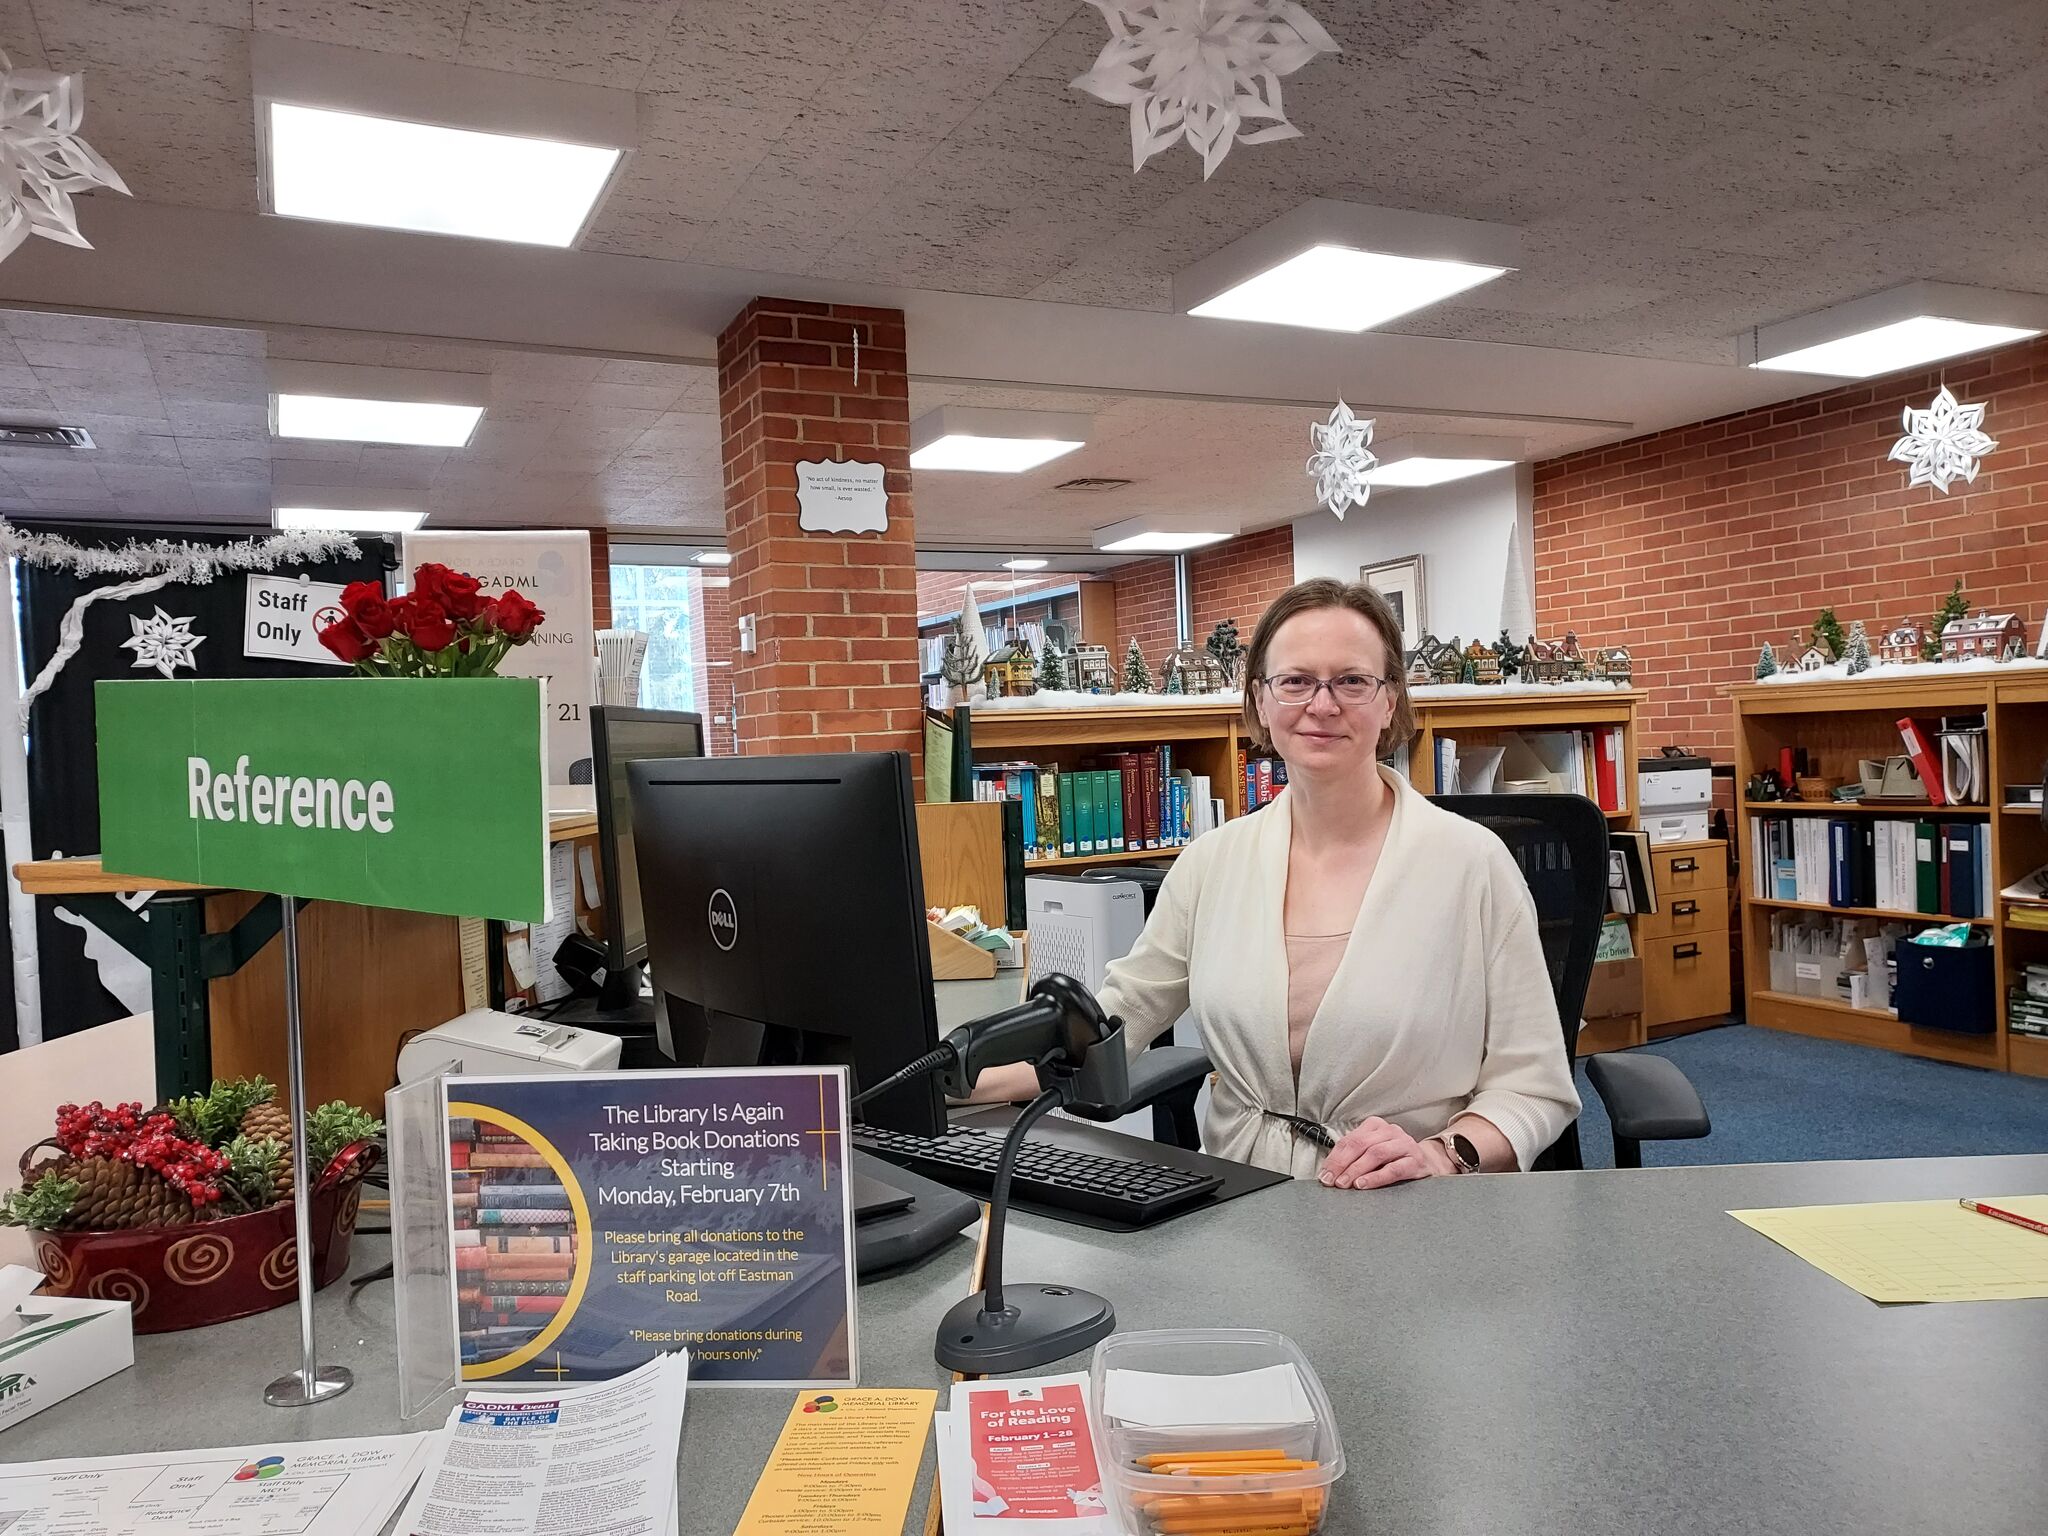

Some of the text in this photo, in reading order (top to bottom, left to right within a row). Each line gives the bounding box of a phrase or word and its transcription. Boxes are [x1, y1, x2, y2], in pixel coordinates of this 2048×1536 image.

[479, 575, 539, 588] GADML
[258, 590, 308, 612] Staff
[256, 622, 302, 646] Only
[558, 703, 582, 721] 21
[188, 754, 395, 834] Reference
[712, 911, 734, 928] DELL
[1609, 947, 1630, 957] Driver
[603, 1102, 784, 1126] The Library Is Again
[589, 1130, 800, 1154] Taking Book Donations
[661, 1158, 734, 1180] Starting
[599, 1183, 800, 1208] Monday, February 7th
[604, 1229, 804, 1245] Please bring all donations to the
[612, 1248, 798, 1266] Library's garage located in the
[618, 1268, 794, 1286] staff parking lot off Eastman
[666, 1290, 702, 1302] Road.
[674, 1329, 704, 1344] bring
[706, 1328, 763, 1341] donations
[764, 1328, 803, 1342] during
[698, 1348, 731, 1361] hours
[584, 1390, 617, 1401] February
[466, 1402, 554, 1411] GADML Events
[980, 1406, 1076, 1419] For the Love
[988, 1416, 1071, 1428] of Reading
[988, 1434, 1040, 1442] February
[290, 1452, 396, 1468] MEMORIAL LIBRARY
[351, 1449, 384, 1458] DOW
